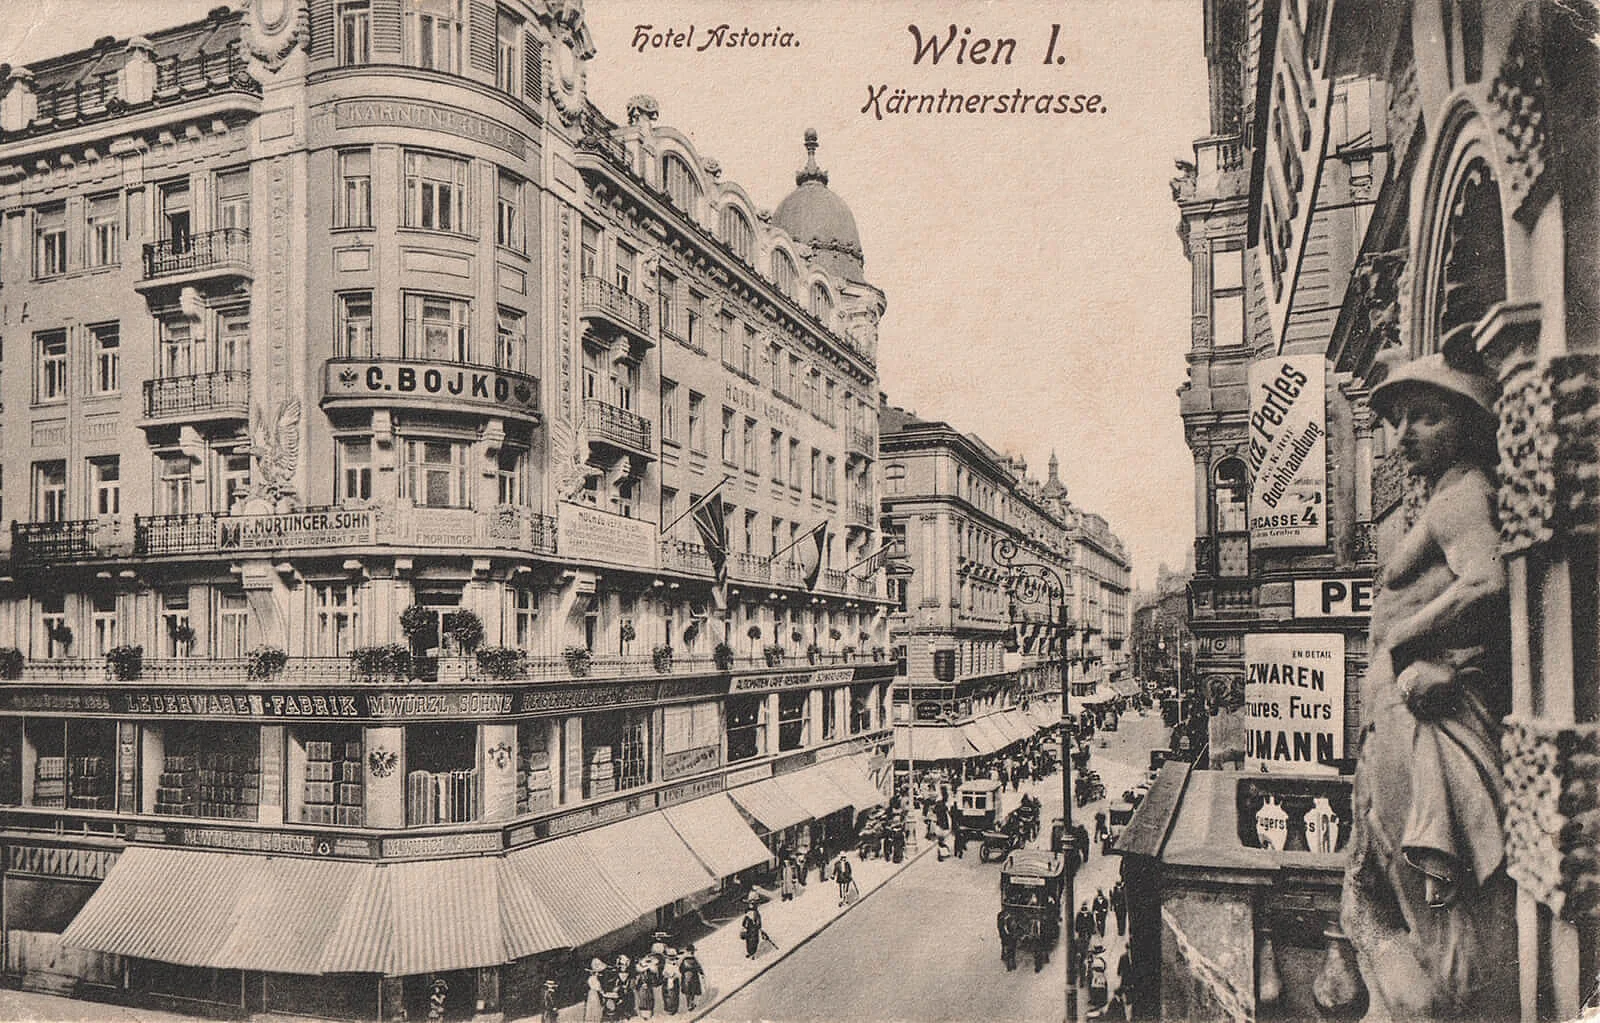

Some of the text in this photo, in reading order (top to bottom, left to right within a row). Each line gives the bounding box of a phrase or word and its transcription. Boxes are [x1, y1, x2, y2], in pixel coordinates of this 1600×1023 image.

[366, 366, 509, 401] C. BOJKO
[1251, 363, 1308, 443] Perles
[1262, 421, 1325, 509] Buchhandlung
[1301, 506, 1319, 526] 4
[1305, 650, 1332, 659] DETAIL
[1289, 695, 1332, 720] Furs
